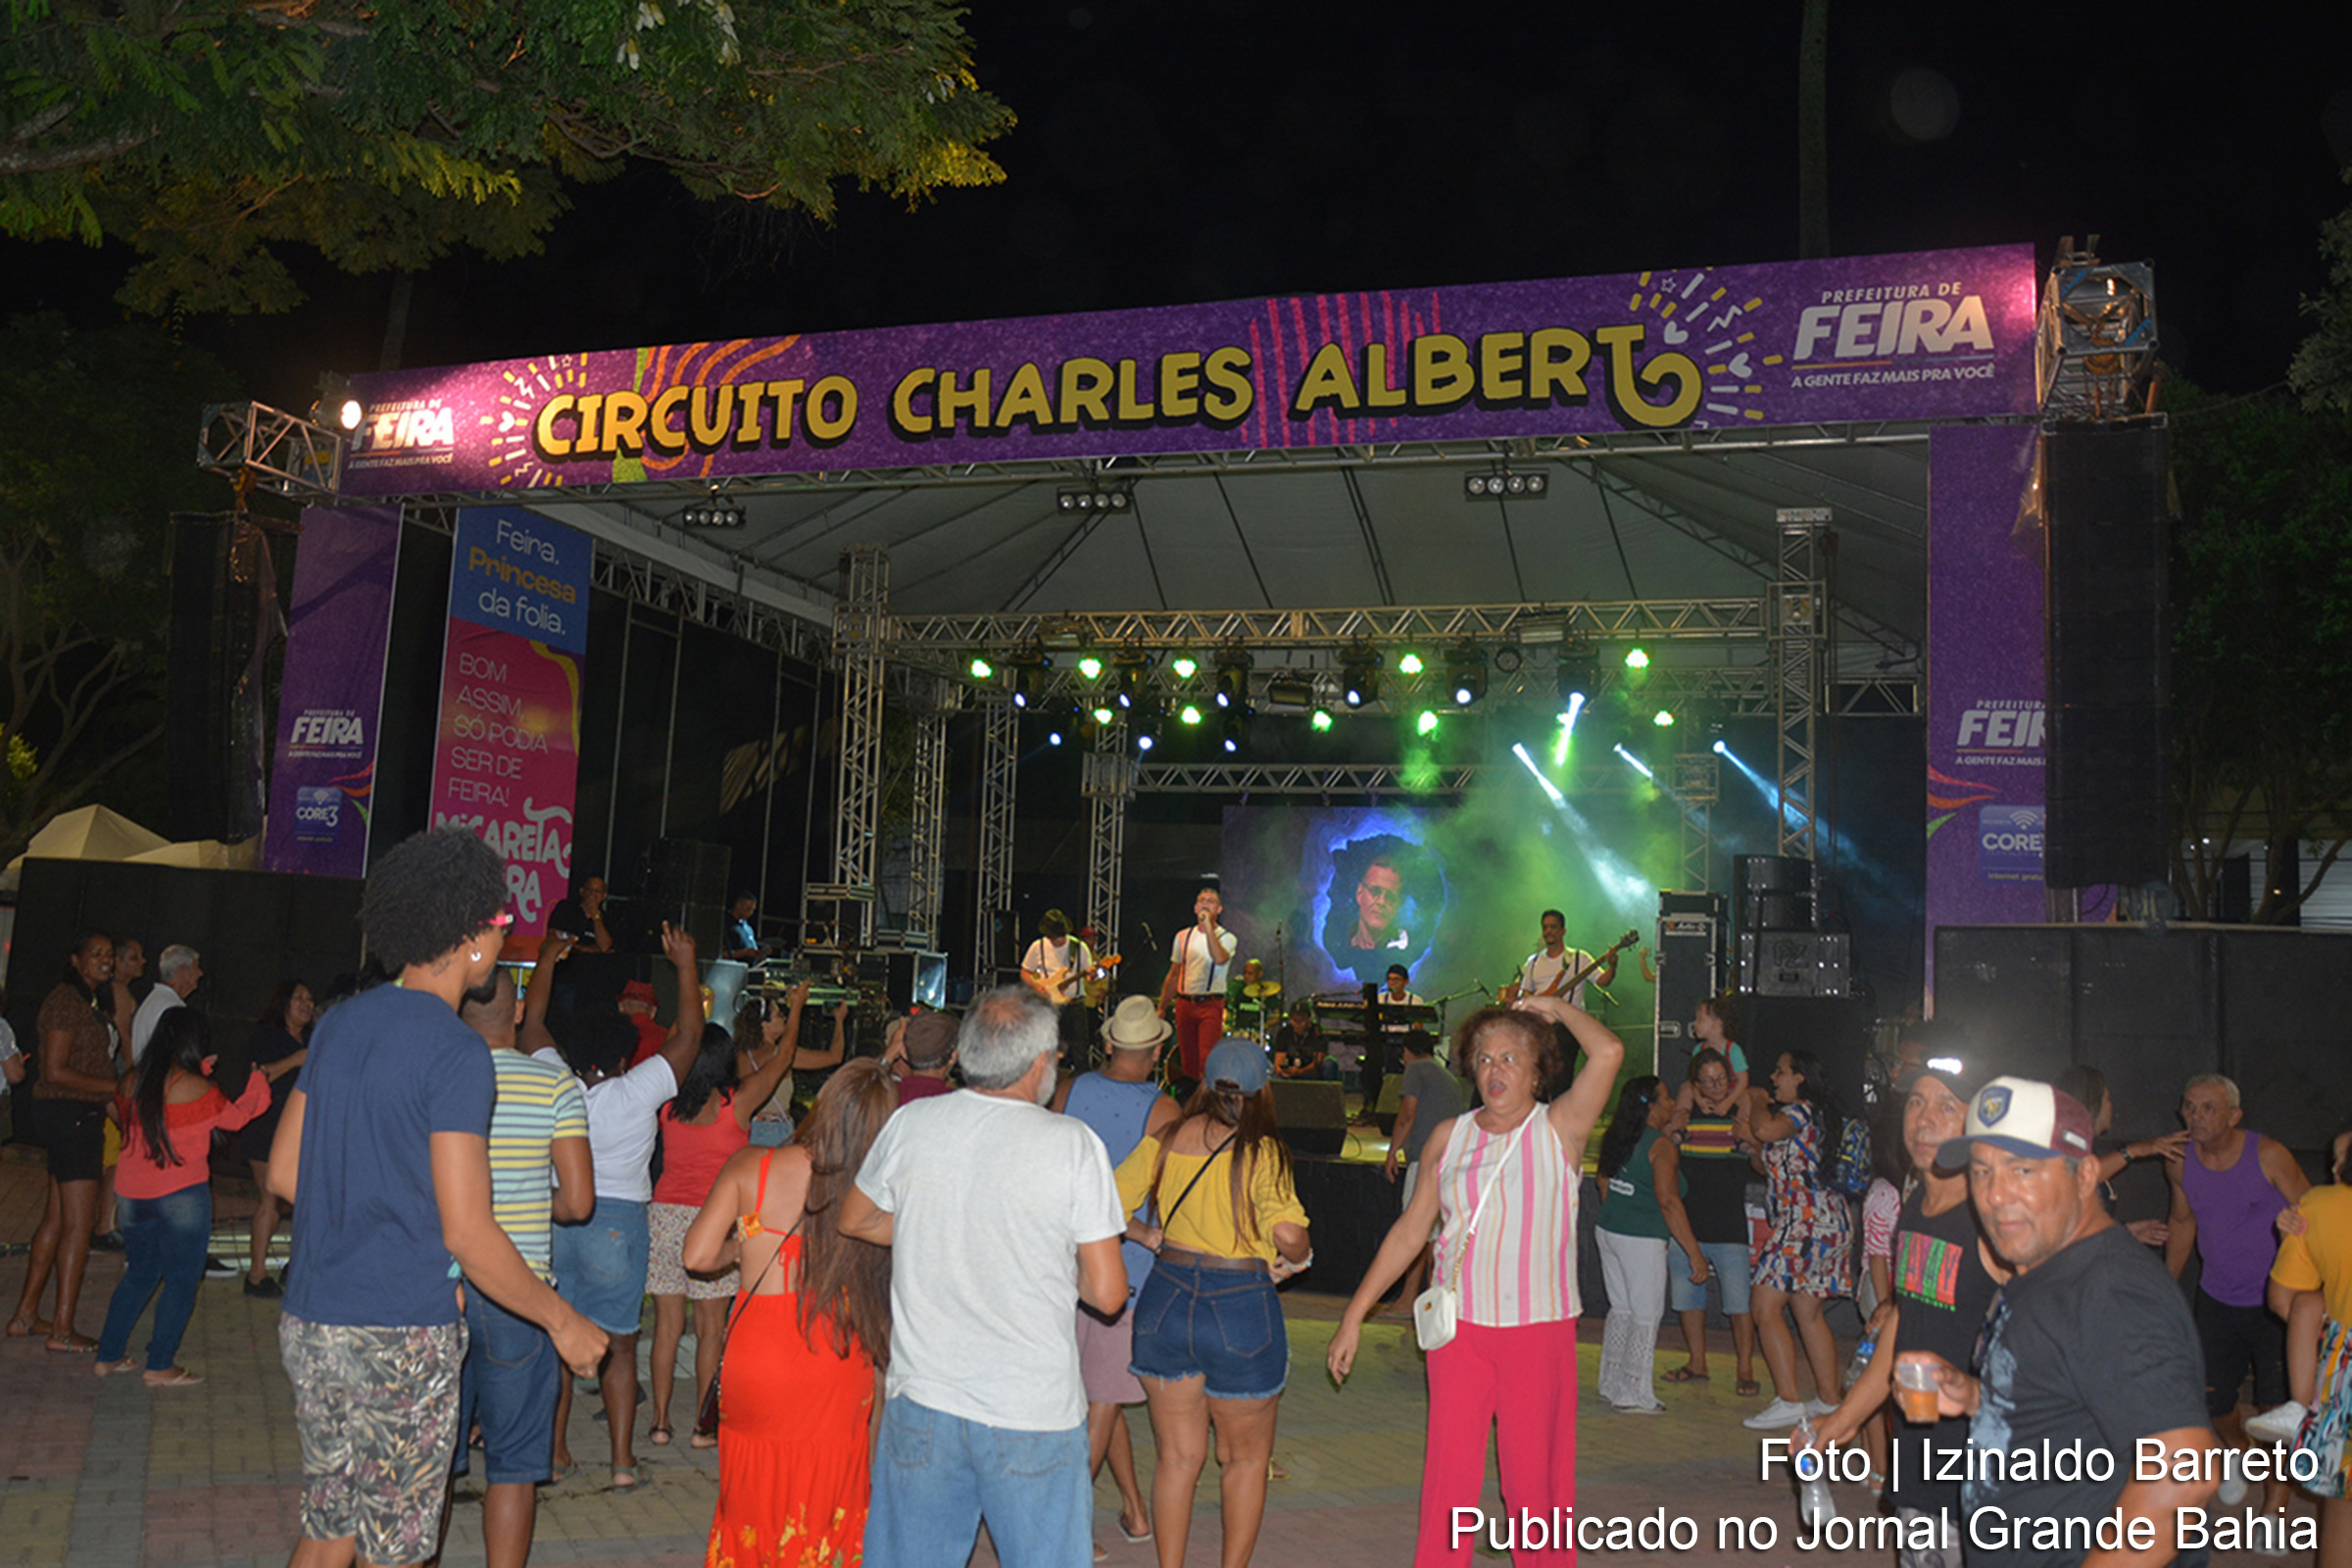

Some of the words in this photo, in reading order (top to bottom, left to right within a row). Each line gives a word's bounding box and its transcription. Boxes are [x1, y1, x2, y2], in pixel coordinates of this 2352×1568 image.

[1821, 283, 1930, 304] PREFEITURA
[1937, 281, 1961, 297] DE
[1792, 295, 1994, 361] FEIRA
[537, 375, 858, 456] CIRCUITO
[892, 346, 1252, 433] CHARLES
[1296, 324, 1702, 427] ALBERT
[1790, 376, 1802, 389] A
[1804, 372, 1851, 387] GENTE
[1852, 370, 1880, 384] FAZ
[1882, 368, 1920, 383] MAIS
[1922, 367, 1951, 381] PRA
[1954, 363, 1995, 379] VOCÊ
[351, 408, 454, 451] FEIRA
[496, 519, 560, 565] Feira.
[468, 546, 576, 605] Princesa
[478, 587, 510, 618] da
[515, 596, 566, 636] folia.
[459, 653, 507, 683] BOM
[456, 685, 524, 722] ASSIM,
[290, 716, 364, 745] FEIRA
[454, 713, 486, 741] SÓ
[489, 722, 549, 754] PODIA
[1957, 710, 2045, 747] FEIR
[451, 746, 493, 773] SER
[496, 755, 523, 780] DE
[1955, 757, 1963, 765] A
[1964, 756, 1995, 765] GENTE
[1996, 756, 2016, 765] FAZ
[448, 777, 511, 808] FEIRA!
